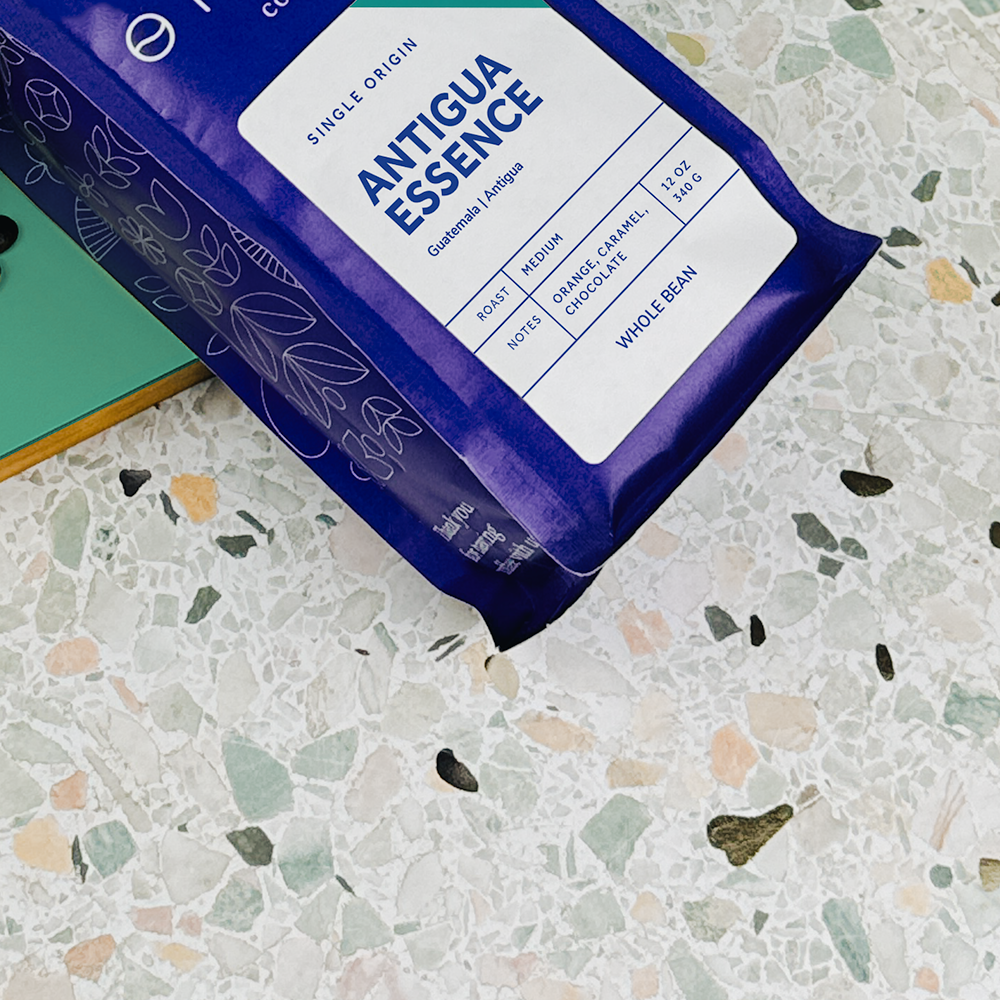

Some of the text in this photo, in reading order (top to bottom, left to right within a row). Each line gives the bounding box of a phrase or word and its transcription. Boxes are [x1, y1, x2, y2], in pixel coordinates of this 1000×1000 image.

[307, 37, 418, 145] SINGLE ORIGIN
[357, 54, 513, 207] ANTIGUA
[384, 78, 544, 236] ESSENCE
[660, 159, 692, 191] 12 OZ
[672, 172, 703, 203] 340 G
[427, 205, 482, 257] Guatemala
[483, 162, 524, 202] Antigua
[520, 232, 564, 277] MEDIUM
[552, 207, 649, 304] ORANGE, CARAMEL,
[565, 250, 628, 316] CHOCOLATE
[476, 286, 510, 322] ROAST
[506, 315, 542, 351] NOTES
[615, 264, 698, 349] WHOLE BEAN
[451, 501, 475, 530] you
